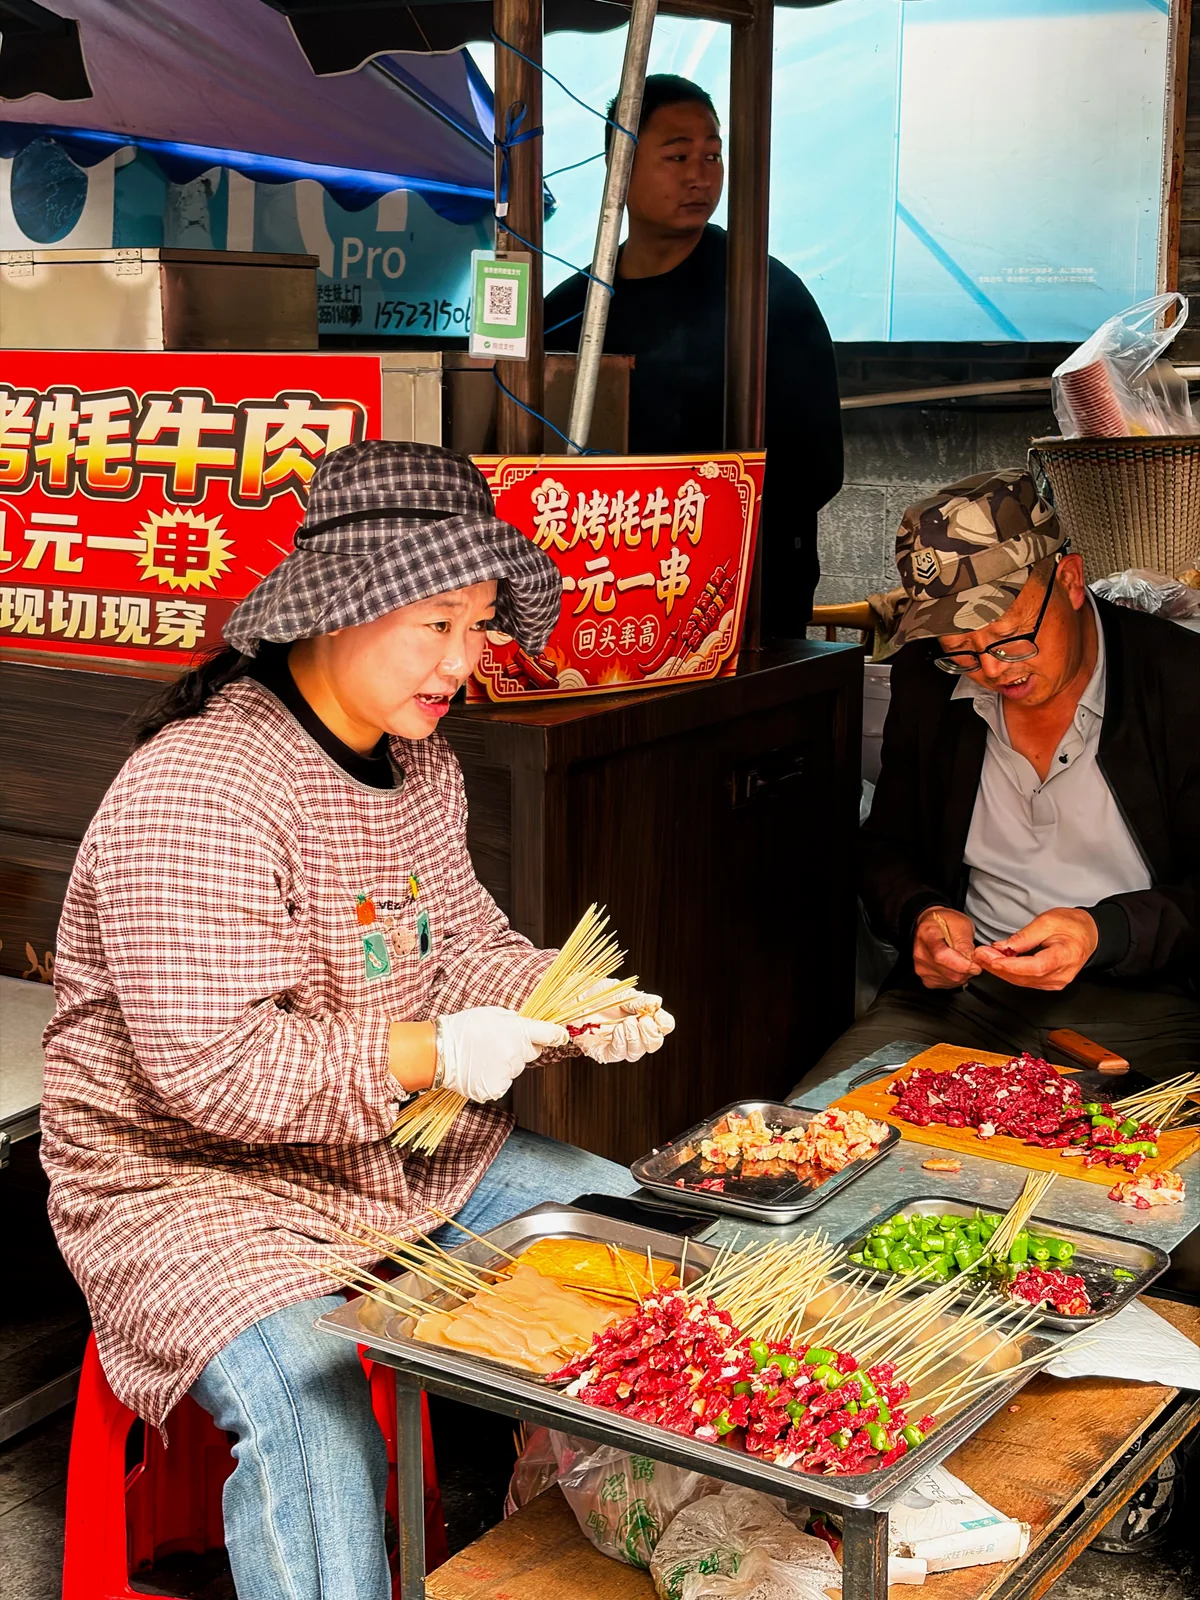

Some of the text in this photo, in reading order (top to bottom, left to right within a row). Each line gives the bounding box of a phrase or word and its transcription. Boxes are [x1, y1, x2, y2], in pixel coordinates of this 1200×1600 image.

[341, 237, 406, 279] Pro
[533, 487, 706, 551] 炭烤牦牛肉
[0, 587, 207, 649] 现切现穿
[578, 622, 656, 652] 回头率高
